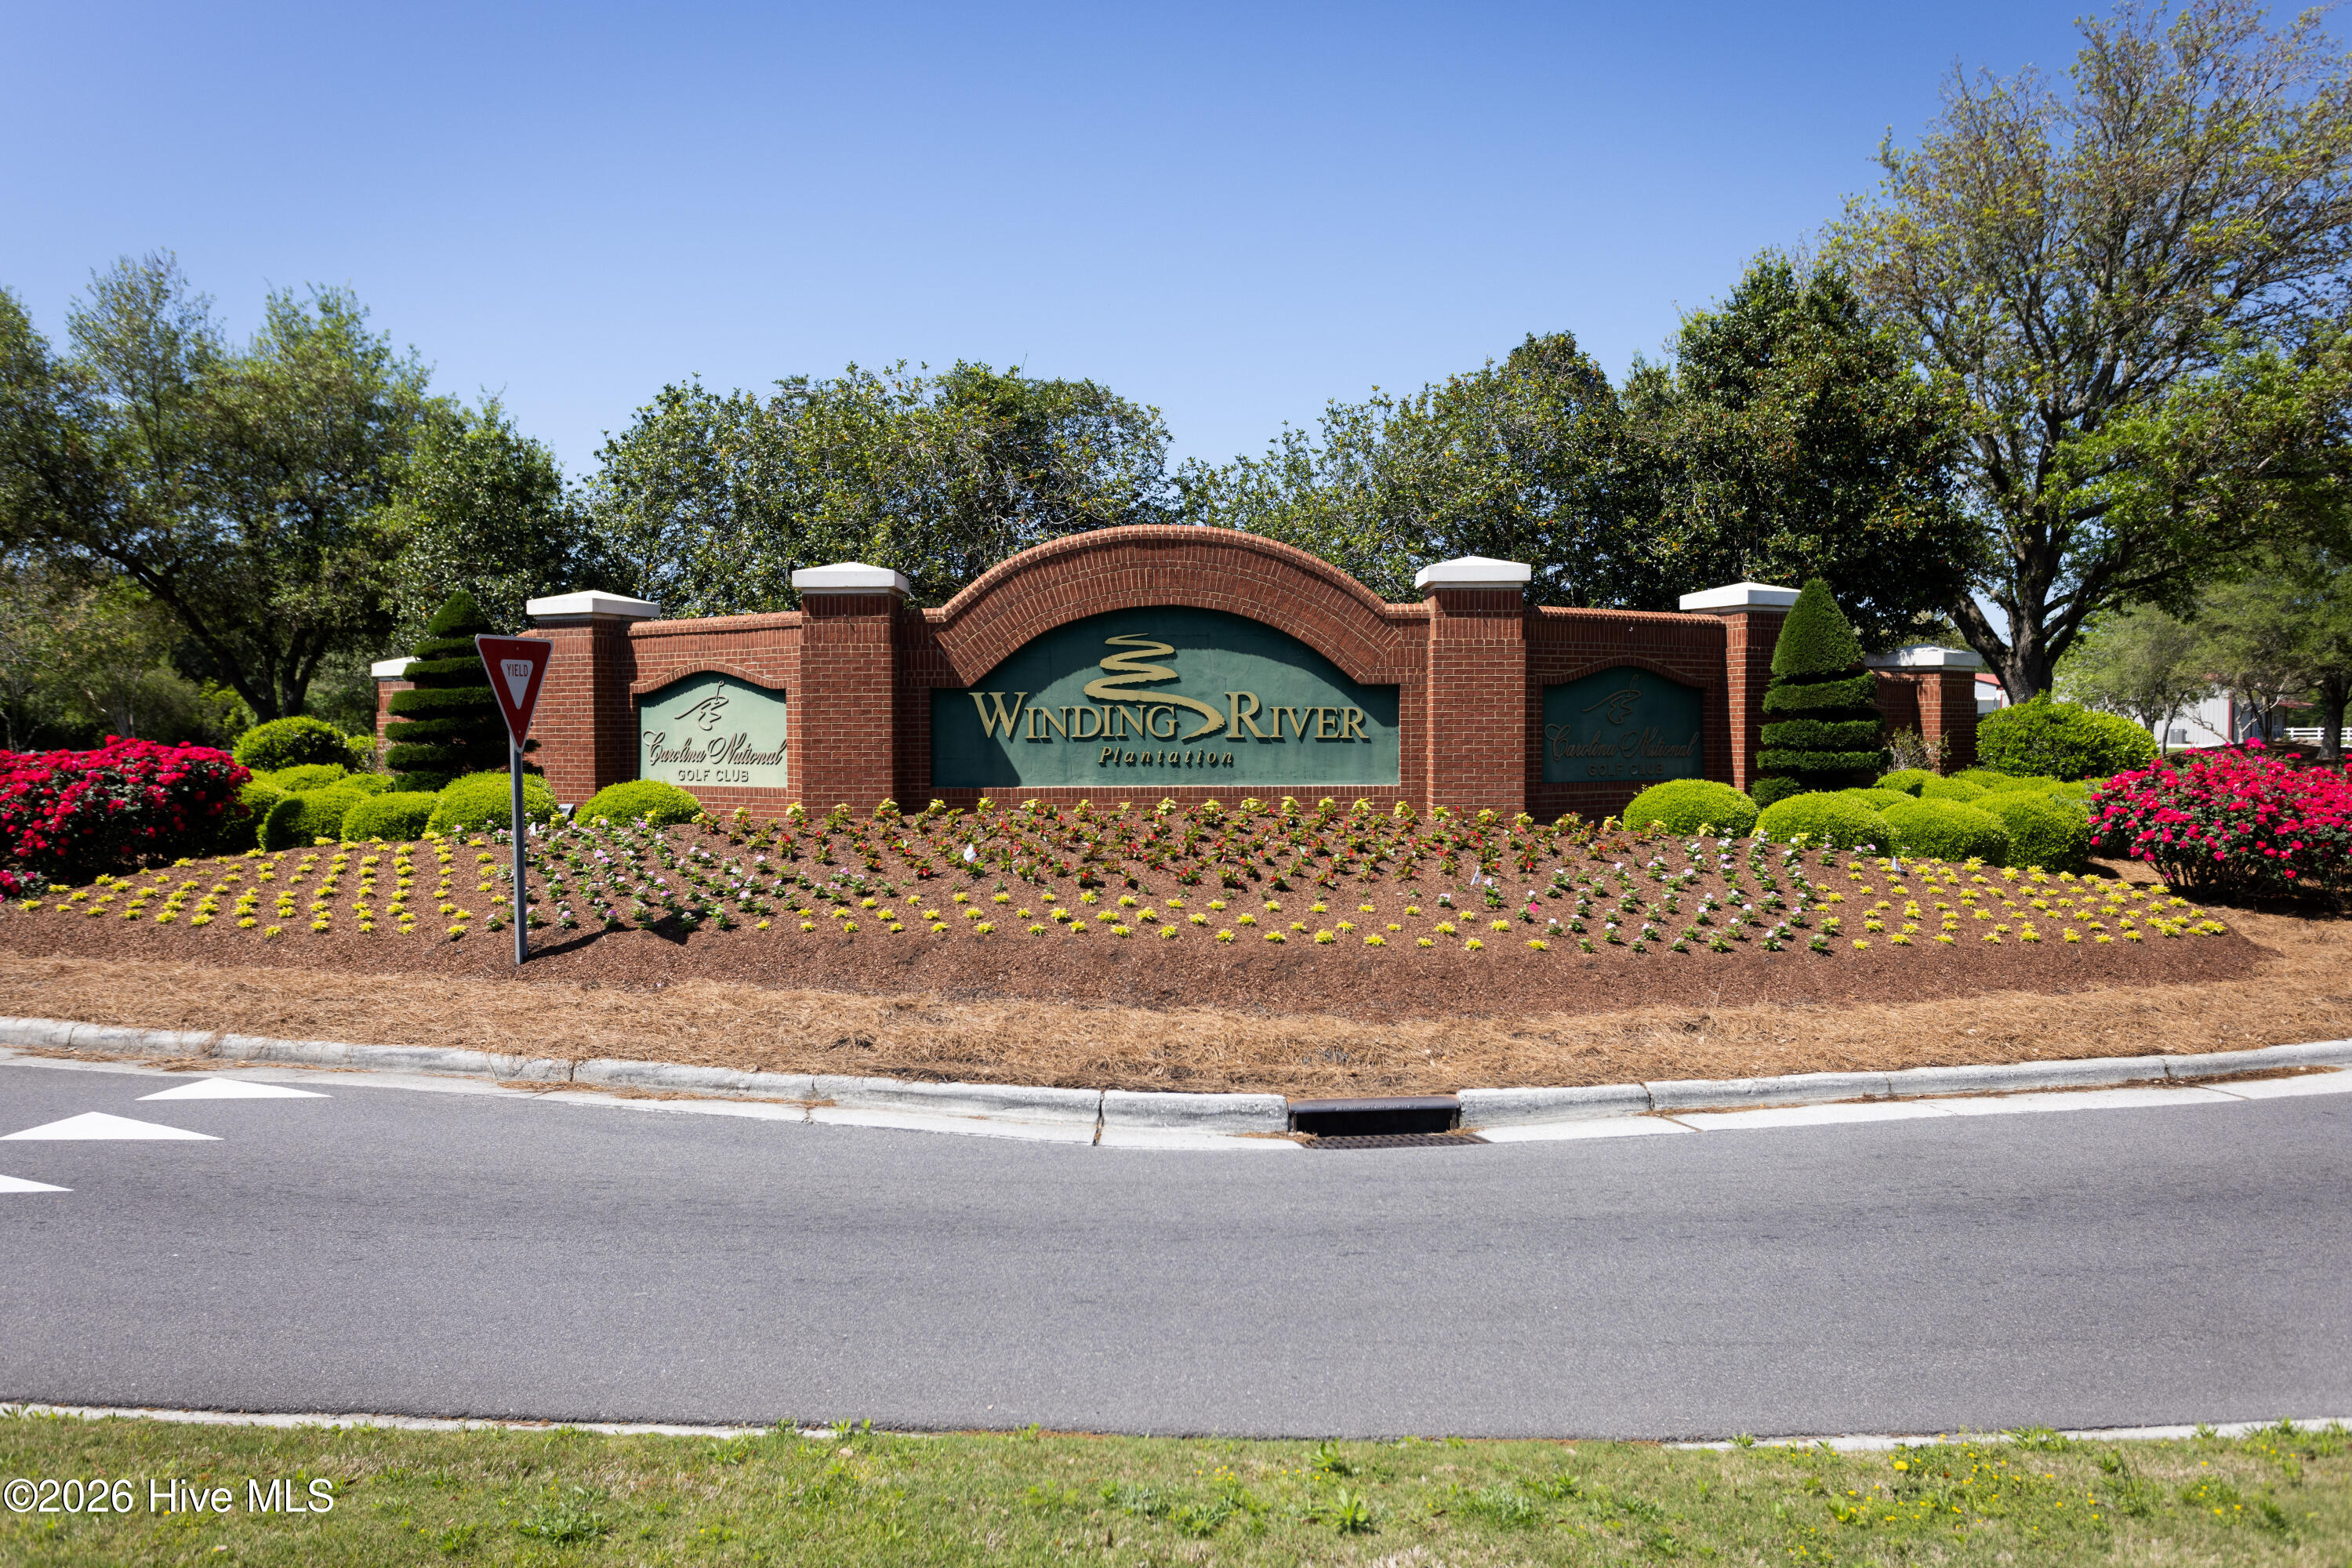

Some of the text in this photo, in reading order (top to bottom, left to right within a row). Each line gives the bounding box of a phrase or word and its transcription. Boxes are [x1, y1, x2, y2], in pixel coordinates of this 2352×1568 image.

[506, 664, 528, 677] YIELD
[968, 691, 1370, 739] WINDING RIVER
[643, 730, 787, 765] Carolina National
[1544, 724, 1700, 760] Carolina National
[1098, 746, 1233, 764] Plantation
[678, 769, 749, 782] GOLF CLUB
[1588, 763, 1664, 776] GOLF CLUB
